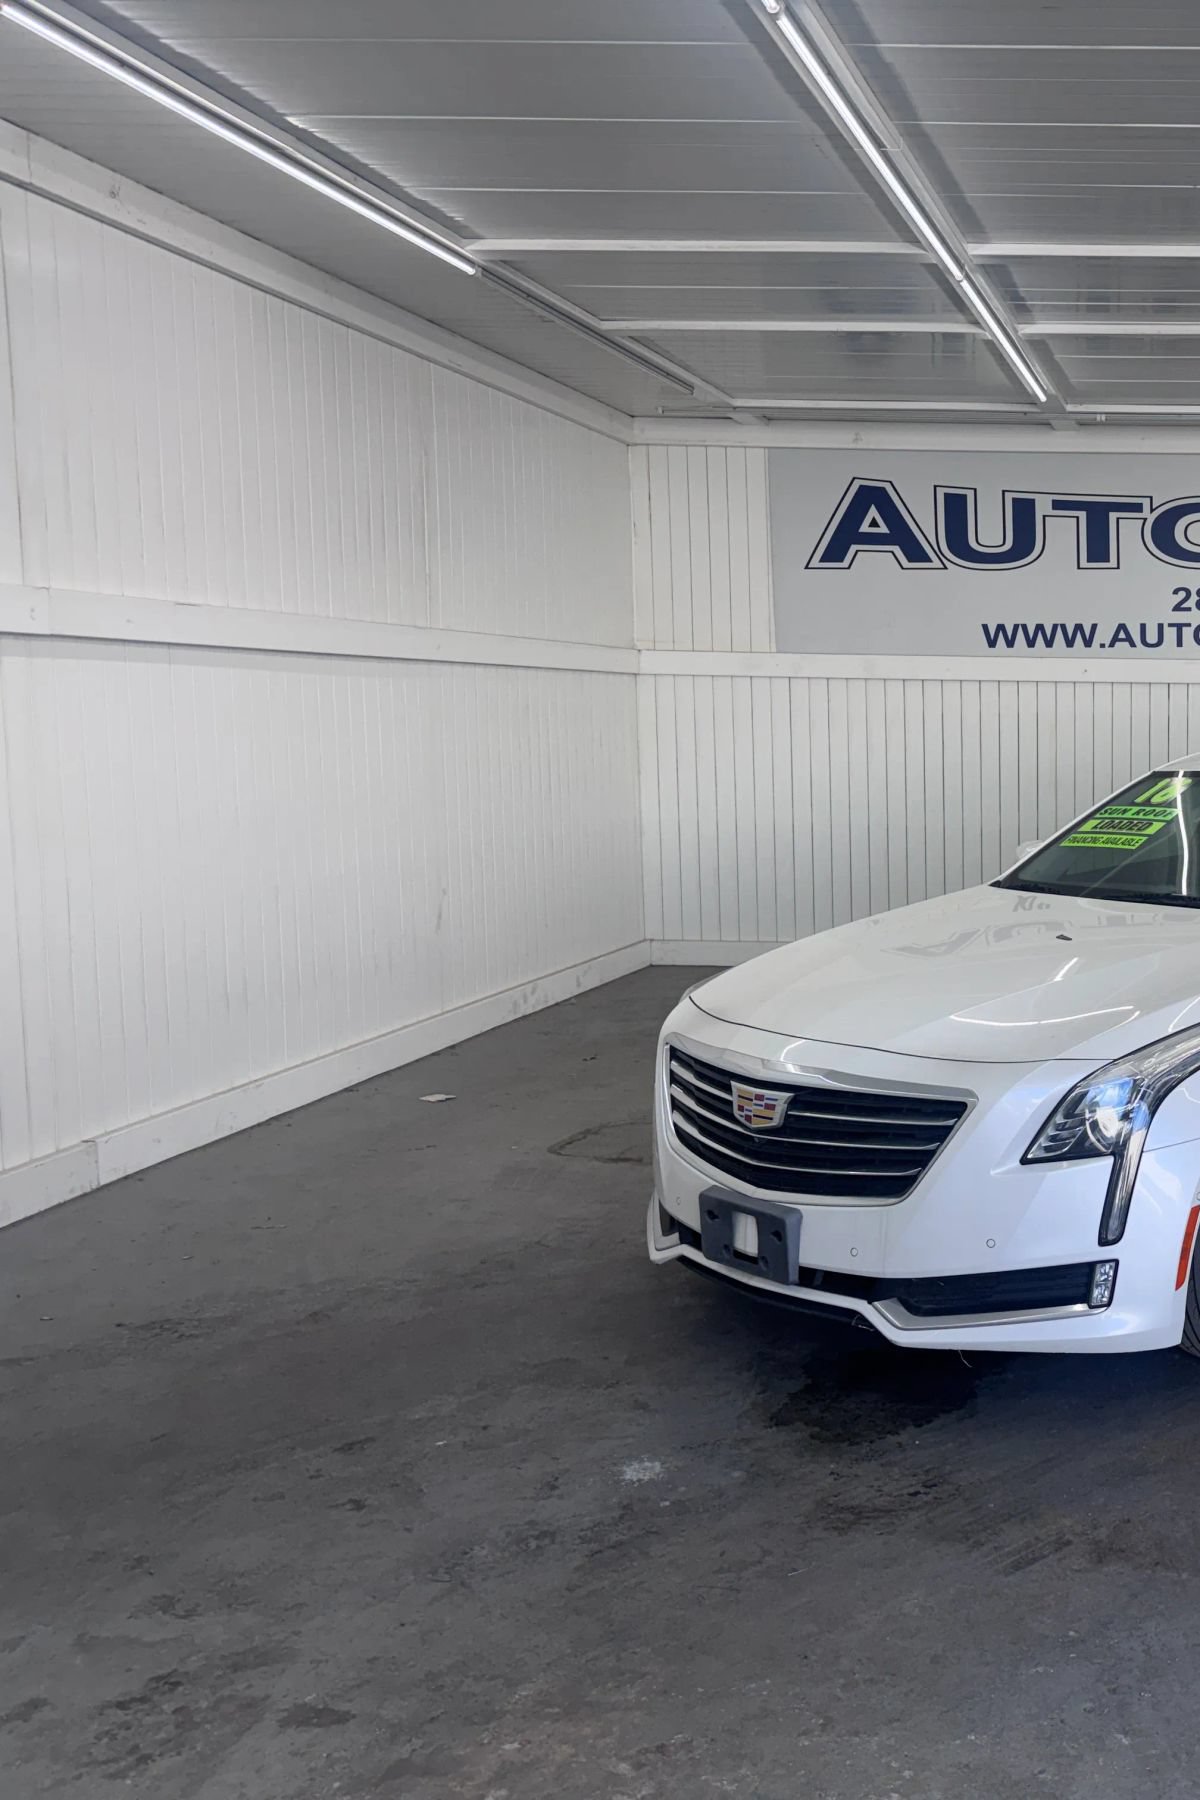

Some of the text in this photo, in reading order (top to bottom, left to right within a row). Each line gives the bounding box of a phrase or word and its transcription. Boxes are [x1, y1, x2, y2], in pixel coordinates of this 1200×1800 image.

[1134, 777, 1192, 804] 16
[1100, 807, 1174, 818] SUN ROOF
[1092, 820, 1153, 832] LOADED
[1101, 837, 1141, 846] AVAILABLE
